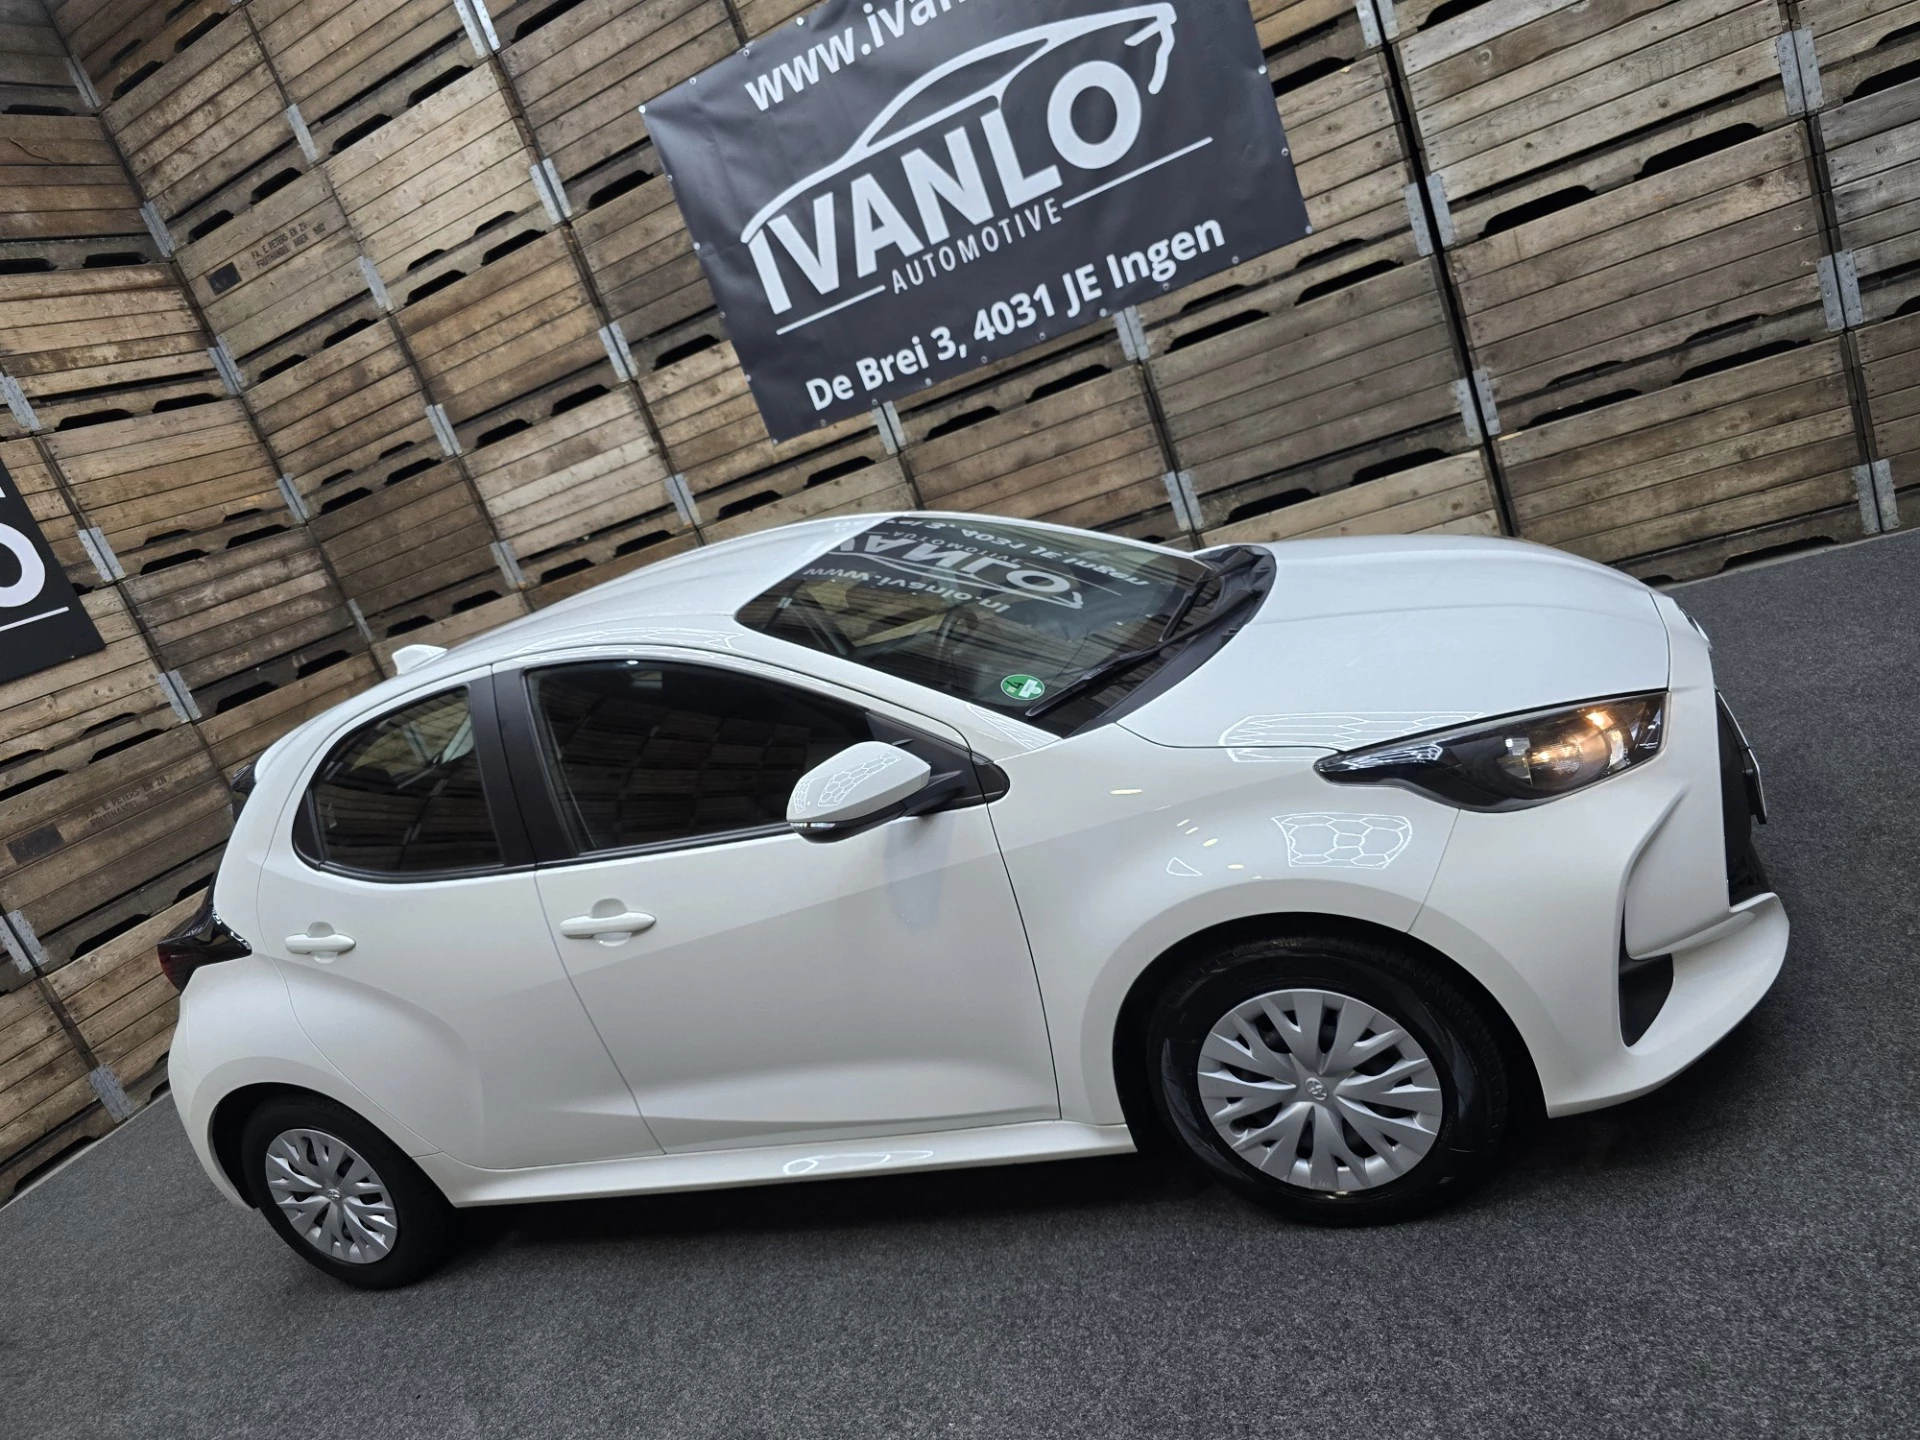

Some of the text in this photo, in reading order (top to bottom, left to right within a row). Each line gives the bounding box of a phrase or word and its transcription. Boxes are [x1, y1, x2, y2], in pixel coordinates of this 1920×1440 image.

[748, 60, 1142, 315] IVANLO
[891, 197, 1063, 294] AUTOMOTIVE
[805, 219, 1225, 411] De Brei 3, 4031 JE Ingen
